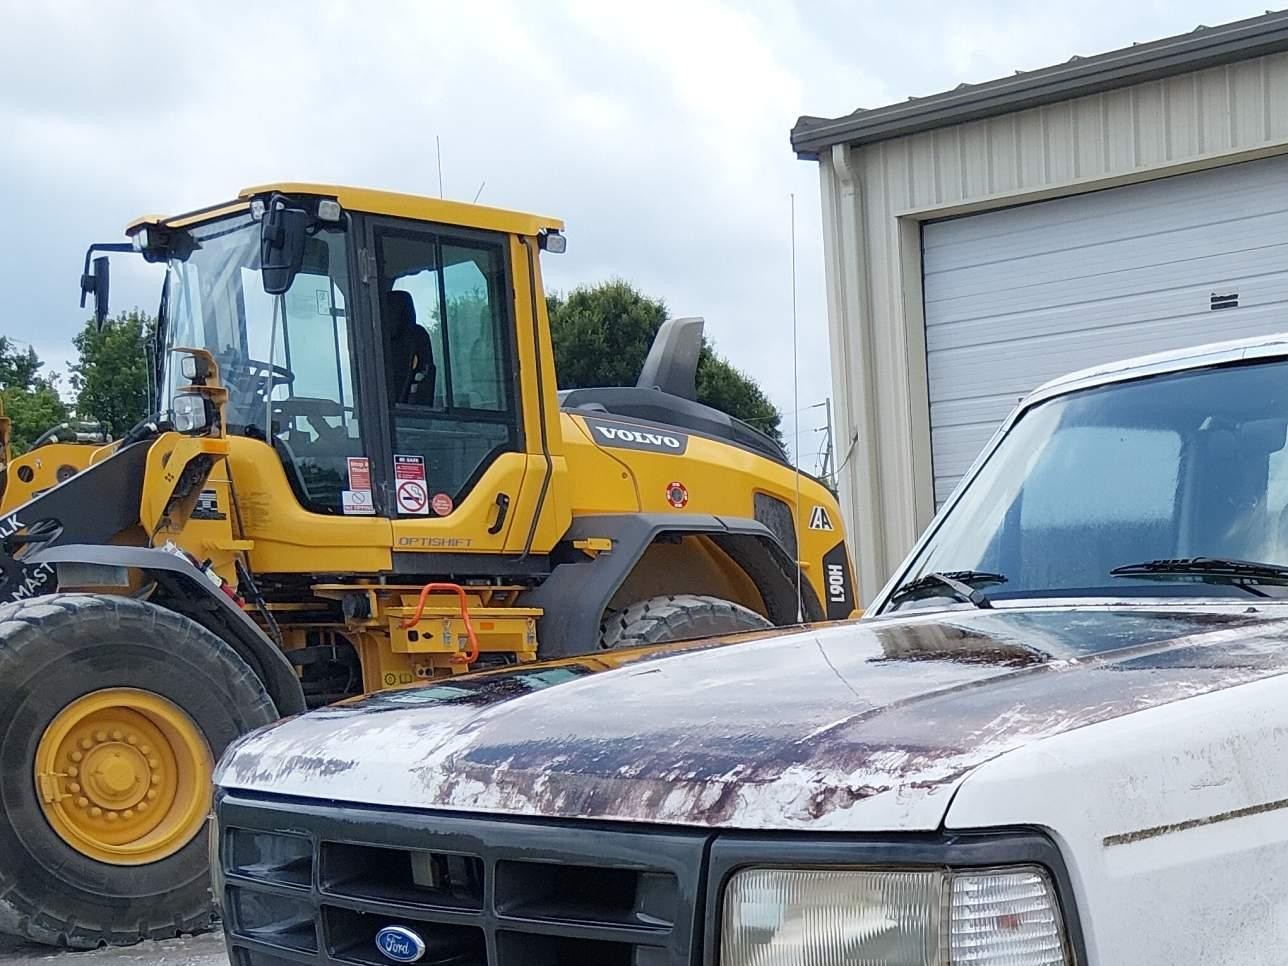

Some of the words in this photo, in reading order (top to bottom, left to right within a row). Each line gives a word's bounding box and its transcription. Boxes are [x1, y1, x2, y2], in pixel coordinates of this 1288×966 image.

[594, 426, 680, 448] VOLVO
[398, 536, 473, 547] OPTISHIFT
[827, 564, 846, 603] L90H
[386, 933, 410, 955] Ford
